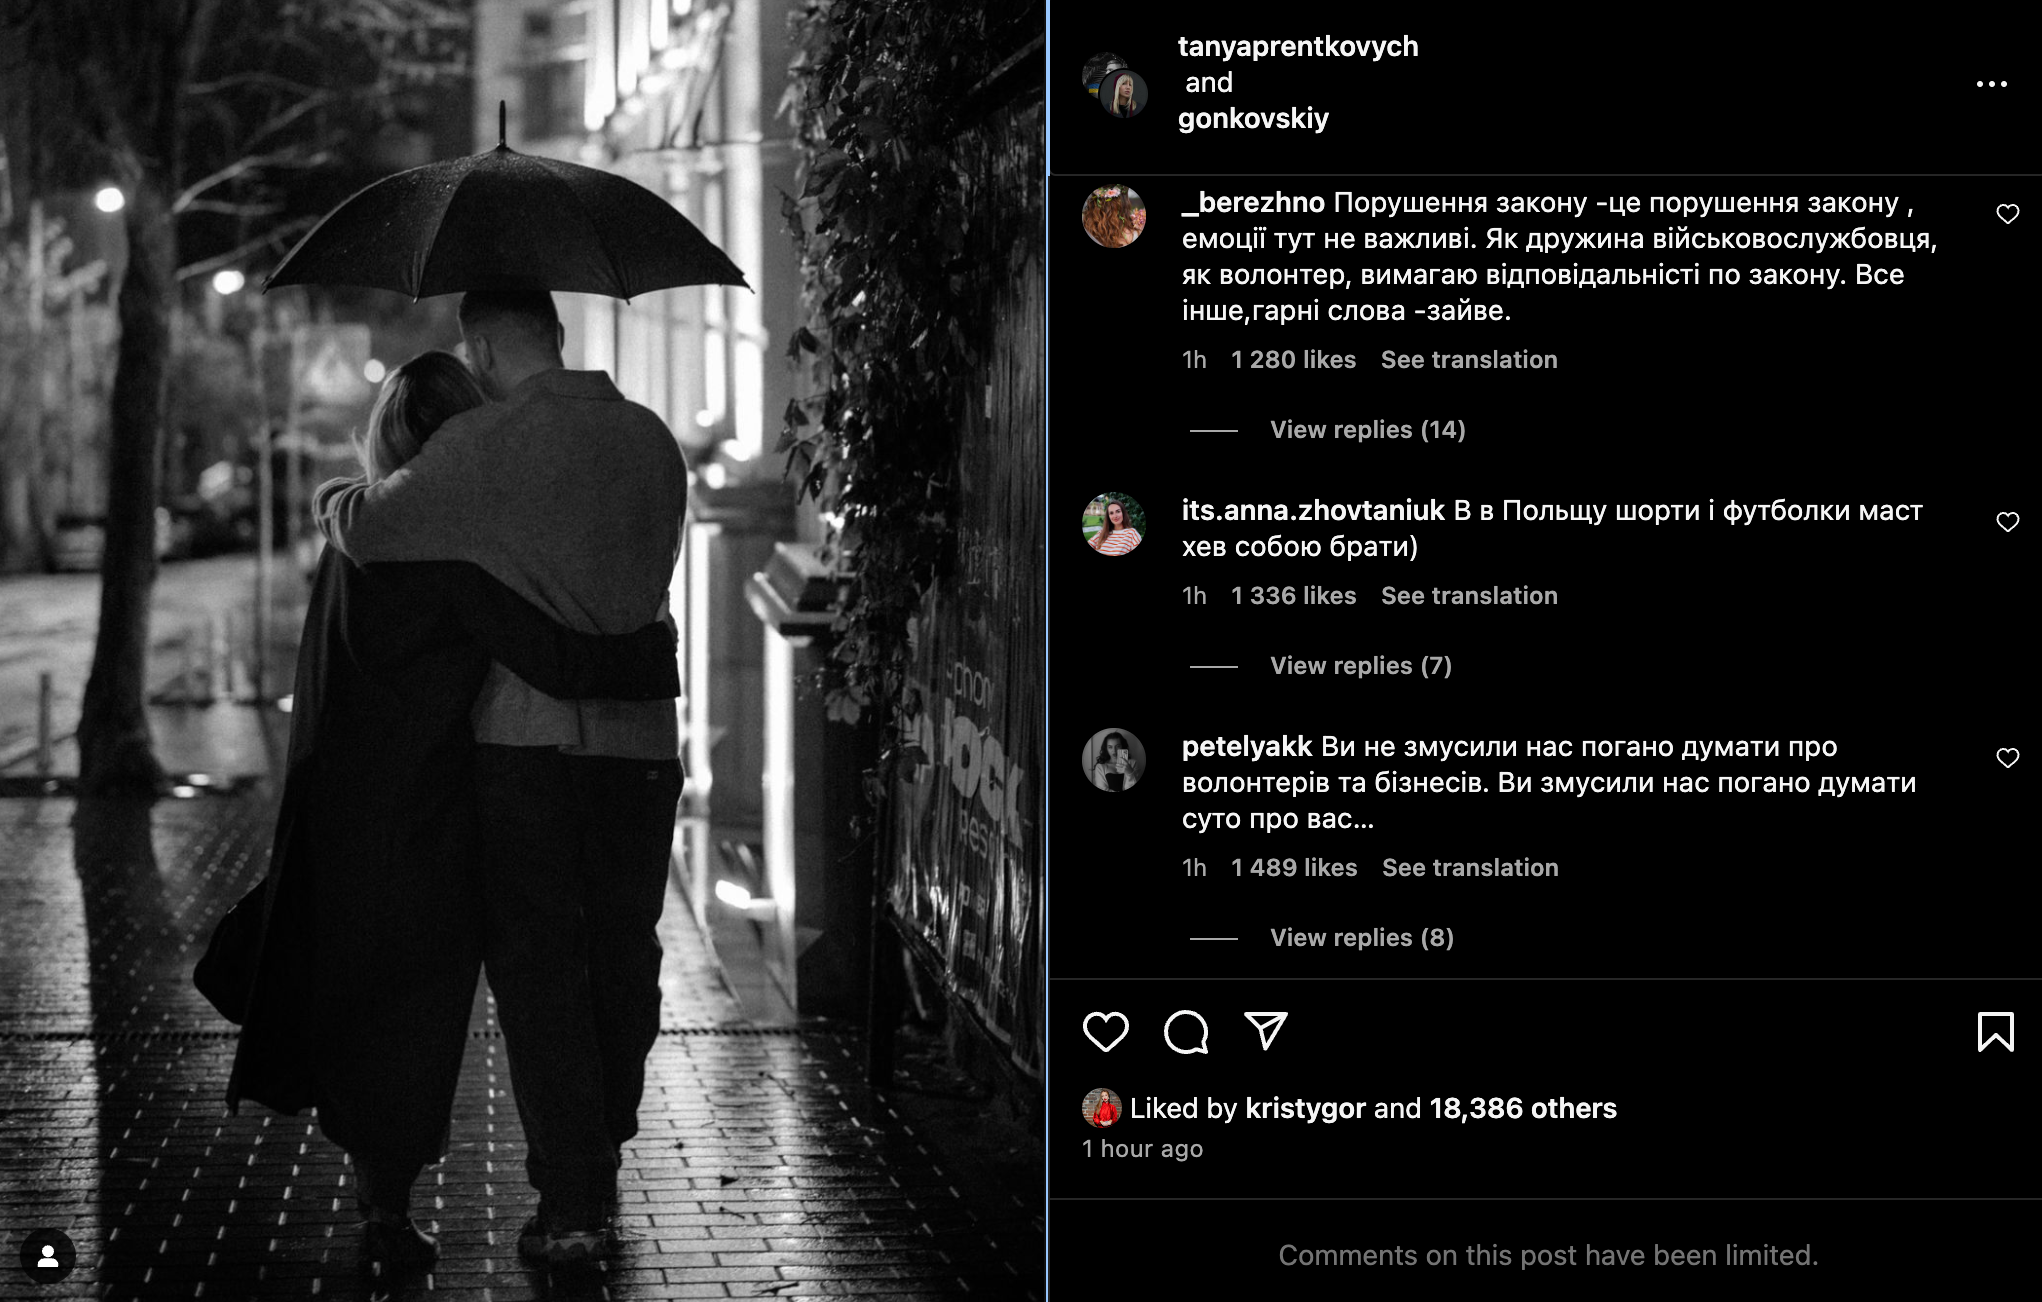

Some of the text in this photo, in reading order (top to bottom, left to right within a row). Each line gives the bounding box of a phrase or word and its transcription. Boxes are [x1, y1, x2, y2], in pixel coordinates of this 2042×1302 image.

[1177, 34, 1419, 63] tanyaprentkovych
[1185, 70, 1233, 94] and
[1178, 105, 1330, 135] gonkovskiy
[1180, 190, 1326, 218] _berezhno
[1334, 191, 1488, 218] Порушення
[1496, 195, 1588, 219] закону
[1596, 195, 1641, 217] -це
[1650, 195, 1799, 219] порушення
[1807, 195, 1900, 219] закону
[1182, 225, 1937, 255] емоції тут не важливі. Як дружина військовослужбовця,
[1181, 261, 1905, 291] як волонтер, вимагаю відповідальністі по закону. Все
[1327, 303, 1405, 322] слова
[1414, 297, 1511, 322] -зайве.
[1182, 349, 1207, 369] 1h
[1303, 348, 1357, 369] likes
[1381, 348, 1558, 370] See translation
[1270, 418, 1466, 444] View replies (14)
[1182, 497, 1924, 527] its.anna.zhovtaniuk В в Польщу шорти і футболки маст
[1182, 533, 1418, 562] хев собою брати)
[1182, 585, 1207, 605] 1h
[1303, 584, 1357, 605] likes
[1381, 584, 1558, 606] See translation
[1270, 654, 1452, 680] View replies (7)
[1182, 734, 1838, 763] petelyakk Ви не змусили нас погано думати про
[1183, 769, 1916, 799] волонтерів та бізнесів. Ви змусили нас погано думати
[1182, 811, 1374, 835] суто про вас...
[1182, 857, 1207, 877] 1h
[1304, 856, 1358, 877] likes
[1382, 856, 1559, 878] See translation
[1270, 926, 1454, 952] View replies (8)
[1131, 1095, 1618, 1125] Liked by kristygor and 18,386 others
[1082, 1138, 1204, 1163] 1 hour ago
[1279, 1243, 1818, 1271] Comments on this post have been limited.
